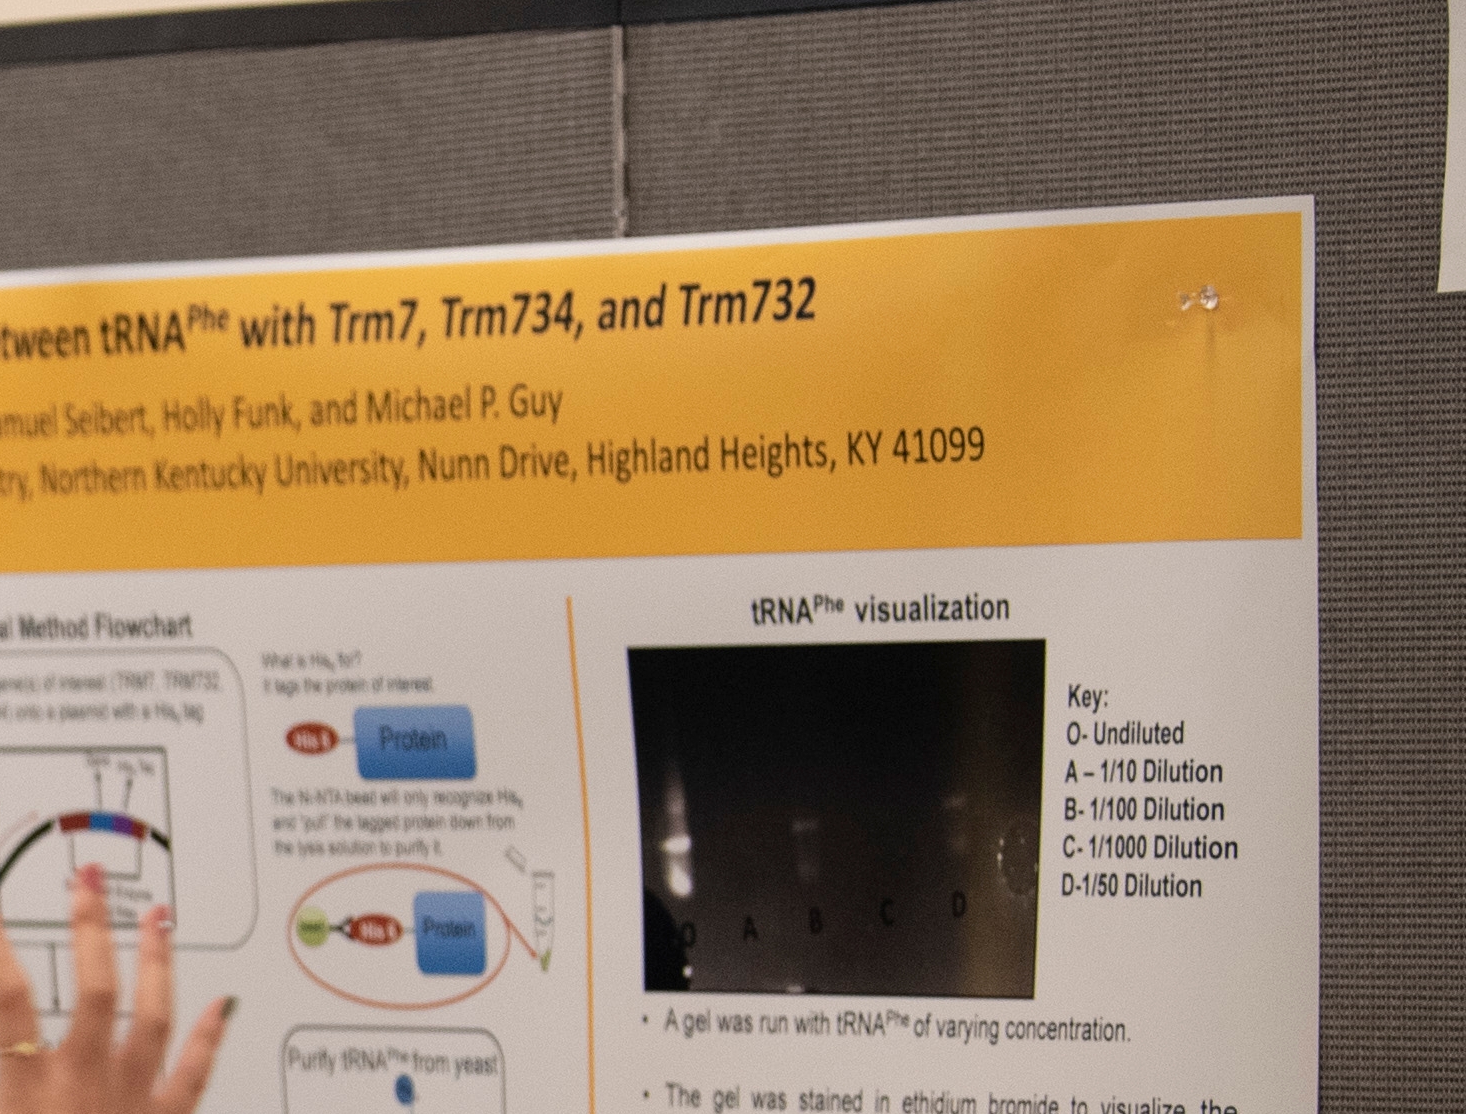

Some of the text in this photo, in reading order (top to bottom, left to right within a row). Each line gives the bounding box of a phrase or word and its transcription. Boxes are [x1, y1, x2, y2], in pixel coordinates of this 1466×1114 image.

[239, 303, 317, 349] with
[596, 283, 668, 331] and
[679, 275, 817, 325] Trm732
[161, 396, 226, 437] Holly
[308, 391, 359, 428] and
[365, 386, 472, 424] Michael
[507, 382, 564, 425] Guy
[38, 462, 148, 495] Northern
[152, 457, 268, 493] Kentucky
[417, 448, 491, 482] Nunn
[586, 436, 711, 484] Highland
[846, 428, 883, 466] KY
[892, 425, 986, 464] 41099
[854, 593, 1011, 623] visualization
[17, 614, 90, 640] Method
[93, 612, 193, 639] Flowchart
[1067, 682, 1109, 714] Key:
[379, 723, 448, 751] Protein
[1065, 719, 1186, 747] O- Undiluted
[1064, 757, 1224, 784] A 1/10 Dilution
[1063, 794, 1226, 822] B- 1/100 Dilution
[1062, 832, 1239, 860] C- 1/1000 Dilution
[1060, 871, 1203, 898] D-1/50 Dilution
[422, 914, 476, 939] Protein
[681, 893, 967, 947] O A B C D
[663, 1005, 679, 1031] A
[682, 1009, 712, 1040] gel
[716, 1012, 754, 1035] was
[758, 1013, 789, 1036] run
[793, 1011, 831, 1036] with
[912, 1011, 933, 1039] of
[935, 1017, 1001, 1047] varying
[287, 1045, 337, 1073] Purify
[413, 1050, 450, 1074] from
[453, 1052, 498, 1078] yeast
[665, 1080, 702, 1109] The
[750, 1090, 788, 1112] was
[798, 1089, 864, 1114] stained
[874, 1093, 891, 1114] in
